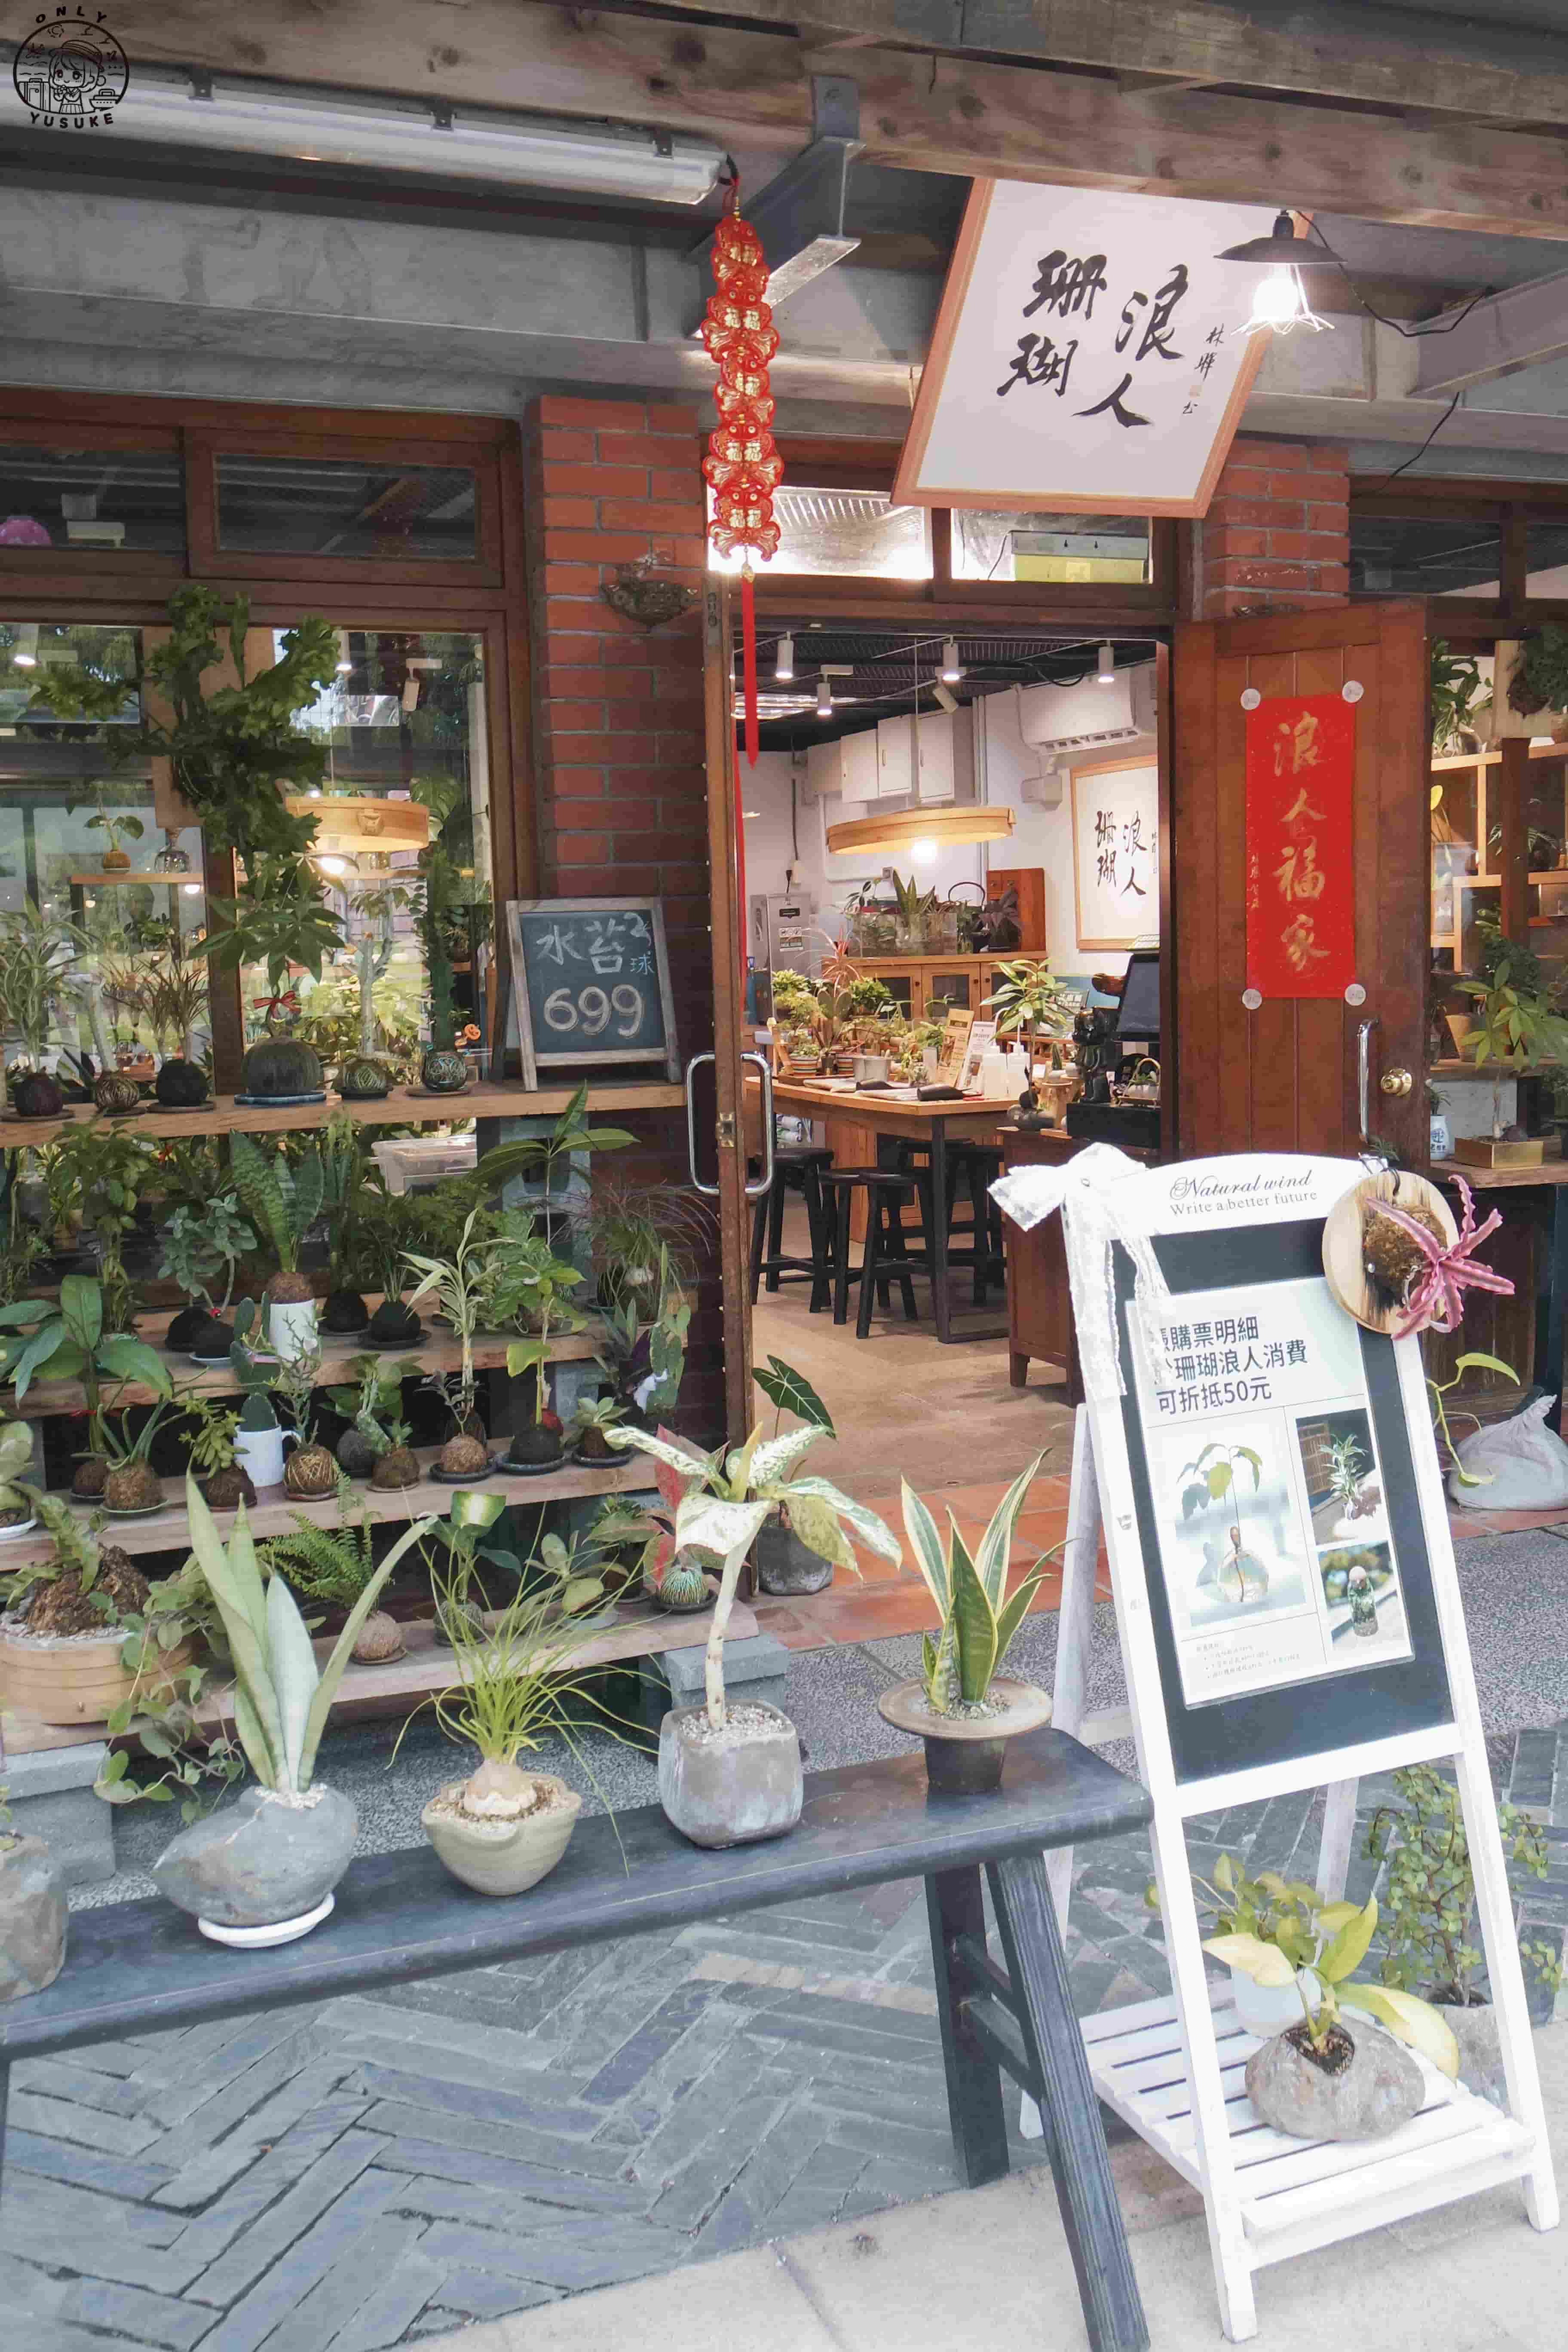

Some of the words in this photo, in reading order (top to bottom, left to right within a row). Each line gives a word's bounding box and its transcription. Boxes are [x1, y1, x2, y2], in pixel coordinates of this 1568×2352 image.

[997, 250, 1108, 397] 珊瑚
[1070, 264, 1188, 428] 浪人
[1094, 810, 1117, 888] 珊瑚
[1121, 810, 1147, 896] 浪人
[543, 983, 643, 1038] 699
[1170, 1173, 1262, 1200] Natural
[1264, 1169, 1313, 1191] wind
[1170, 1201, 1213, 1217] Write
[1216, 1202, 1224, 1211] a
[1227, 1196, 1269, 1210] better
[1274, 1191, 1317, 1204] future
[1165, 1339, 1308, 1381] 珊瑚浪人消費
[1156, 1376, 1272, 1415] 可折抵50元
